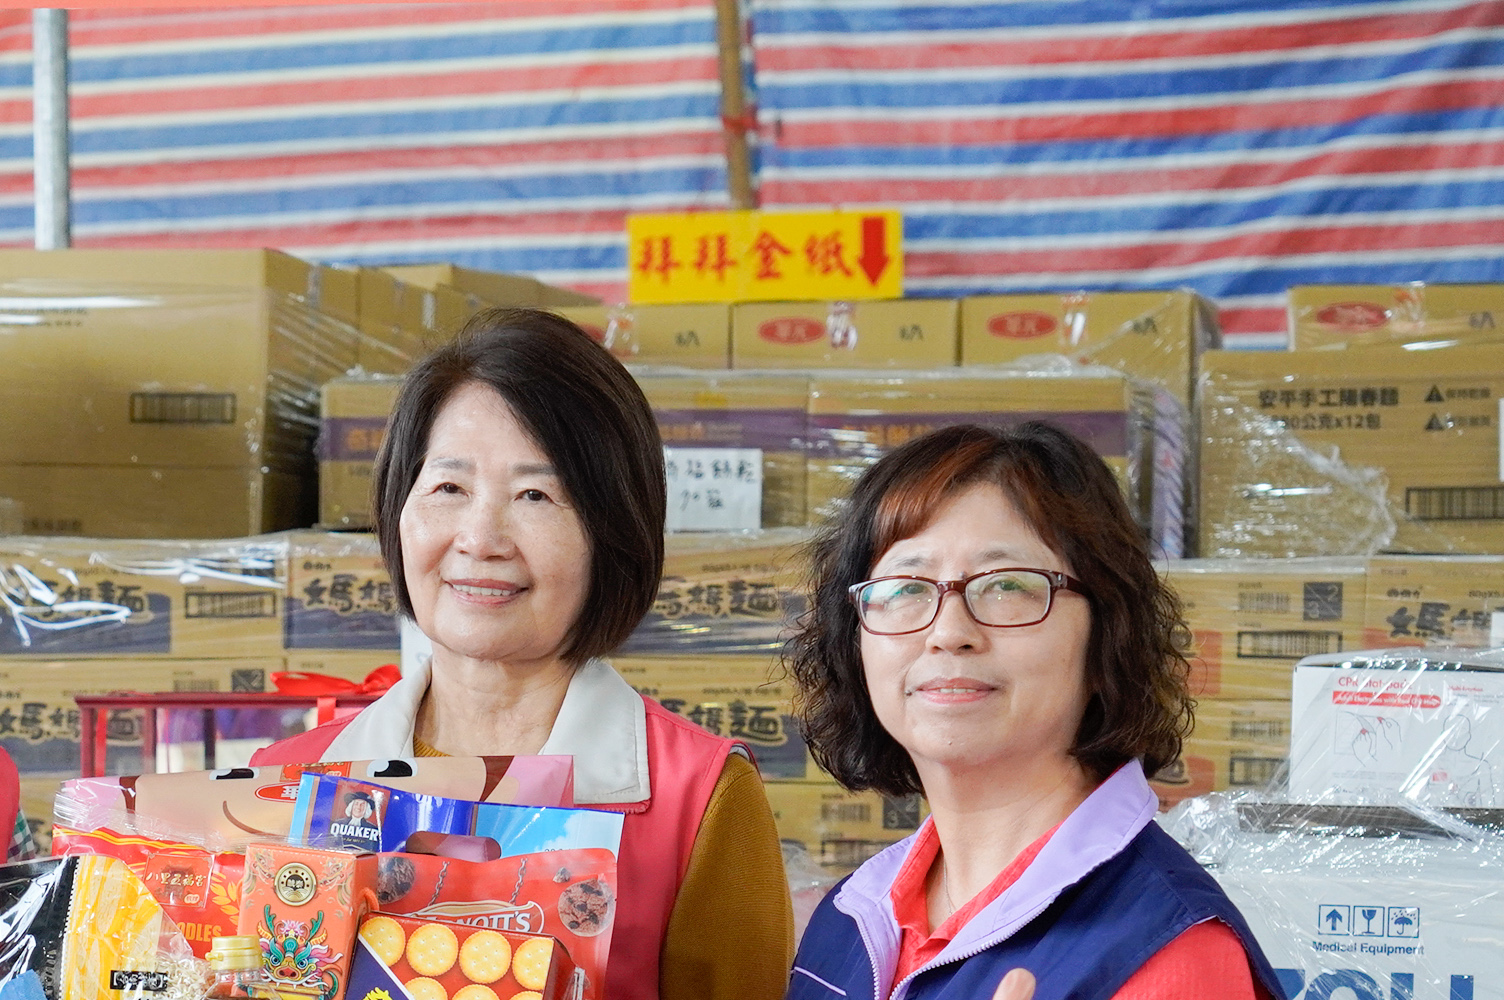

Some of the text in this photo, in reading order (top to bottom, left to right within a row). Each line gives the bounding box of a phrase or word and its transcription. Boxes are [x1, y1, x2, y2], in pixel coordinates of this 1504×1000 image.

[330, 823, 380, 842] QUAKER
[1311, 940, 1425, 956] Medical Equipment
